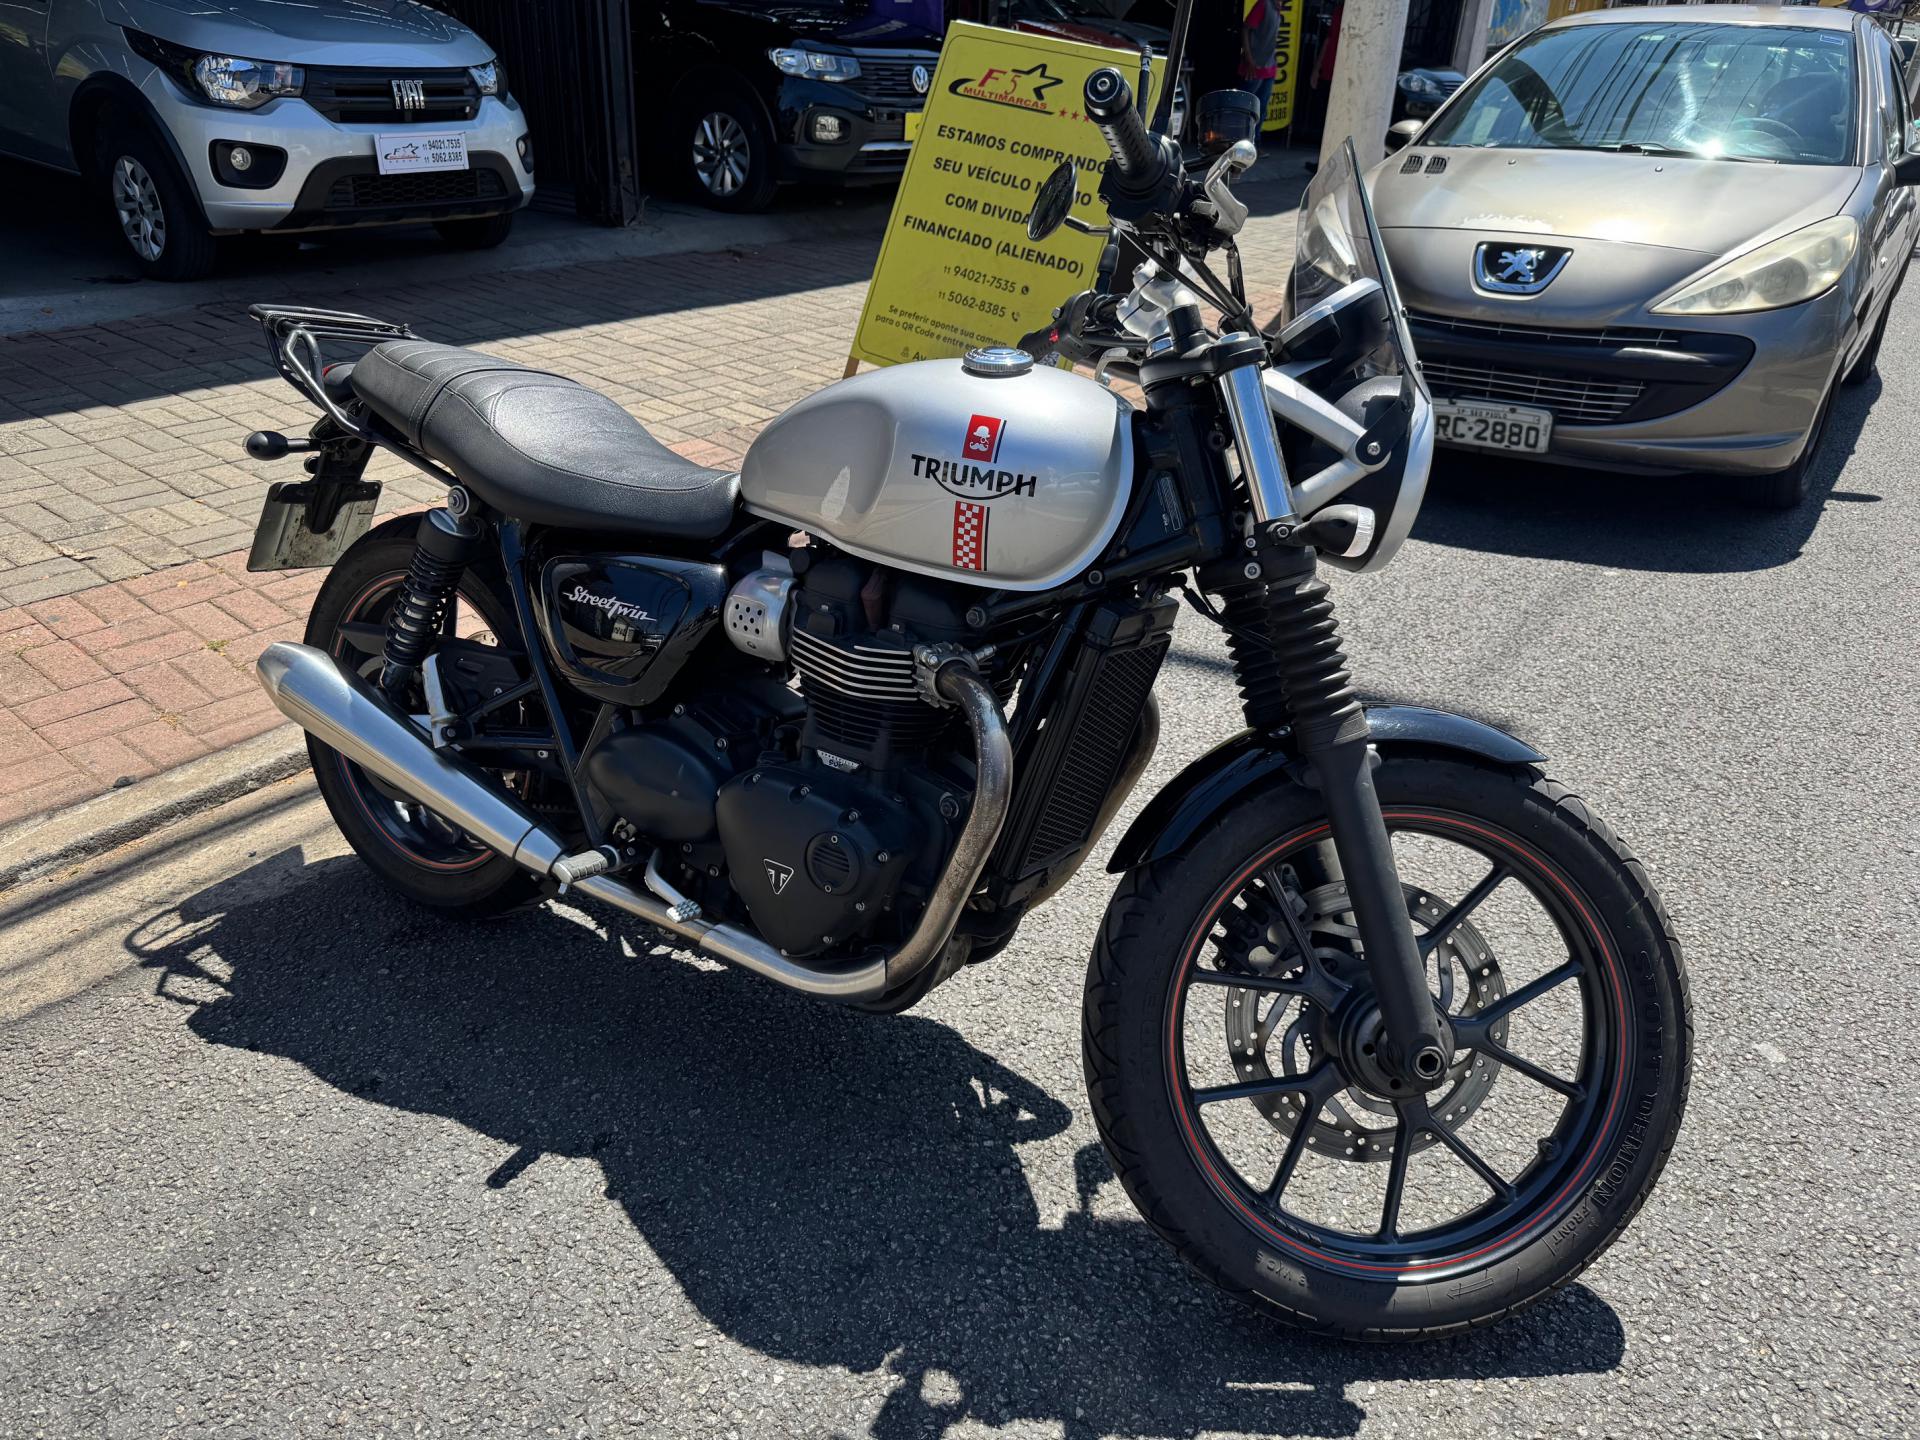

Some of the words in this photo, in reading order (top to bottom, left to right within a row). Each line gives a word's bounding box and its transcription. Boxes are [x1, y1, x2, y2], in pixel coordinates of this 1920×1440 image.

[391, 80, 425, 109] FIAT
[963, 86, 1048, 110] MULTIMARCAS
[428, 138, 461, 150] 94021.7535
[937, 124, 1006, 151] ESTAMOS
[432, 152, 463, 163] 5062.8385
[933, 156, 963, 174] SEU
[967, 165, 1031, 191] VEÍCULO
[945, 193, 977, 212] COM
[903, 215, 992, 250] FINANCIADO
[995, 240, 1084, 279] (ALIENADO)
[943, 265, 951, 274] 11
[953, 265, 1016, 294] 94021-7535
[938, 291, 946, 299] 11
[947, 291, 1006, 318] 5062-8385
[875, 314, 894, 326] para
[902, 321, 914, 332] QR
[915, 326, 935, 339] Code
[942, 336, 964, 348] entre
[889, 305, 898, 314] Se
[899, 309, 929, 324] preferir
[930, 319, 959, 335] aponte
[960, 328, 975, 338] sua
[911, 453, 1037, 500] TRIUMPH
[1551, 1205, 1591, 1246] FRONT
